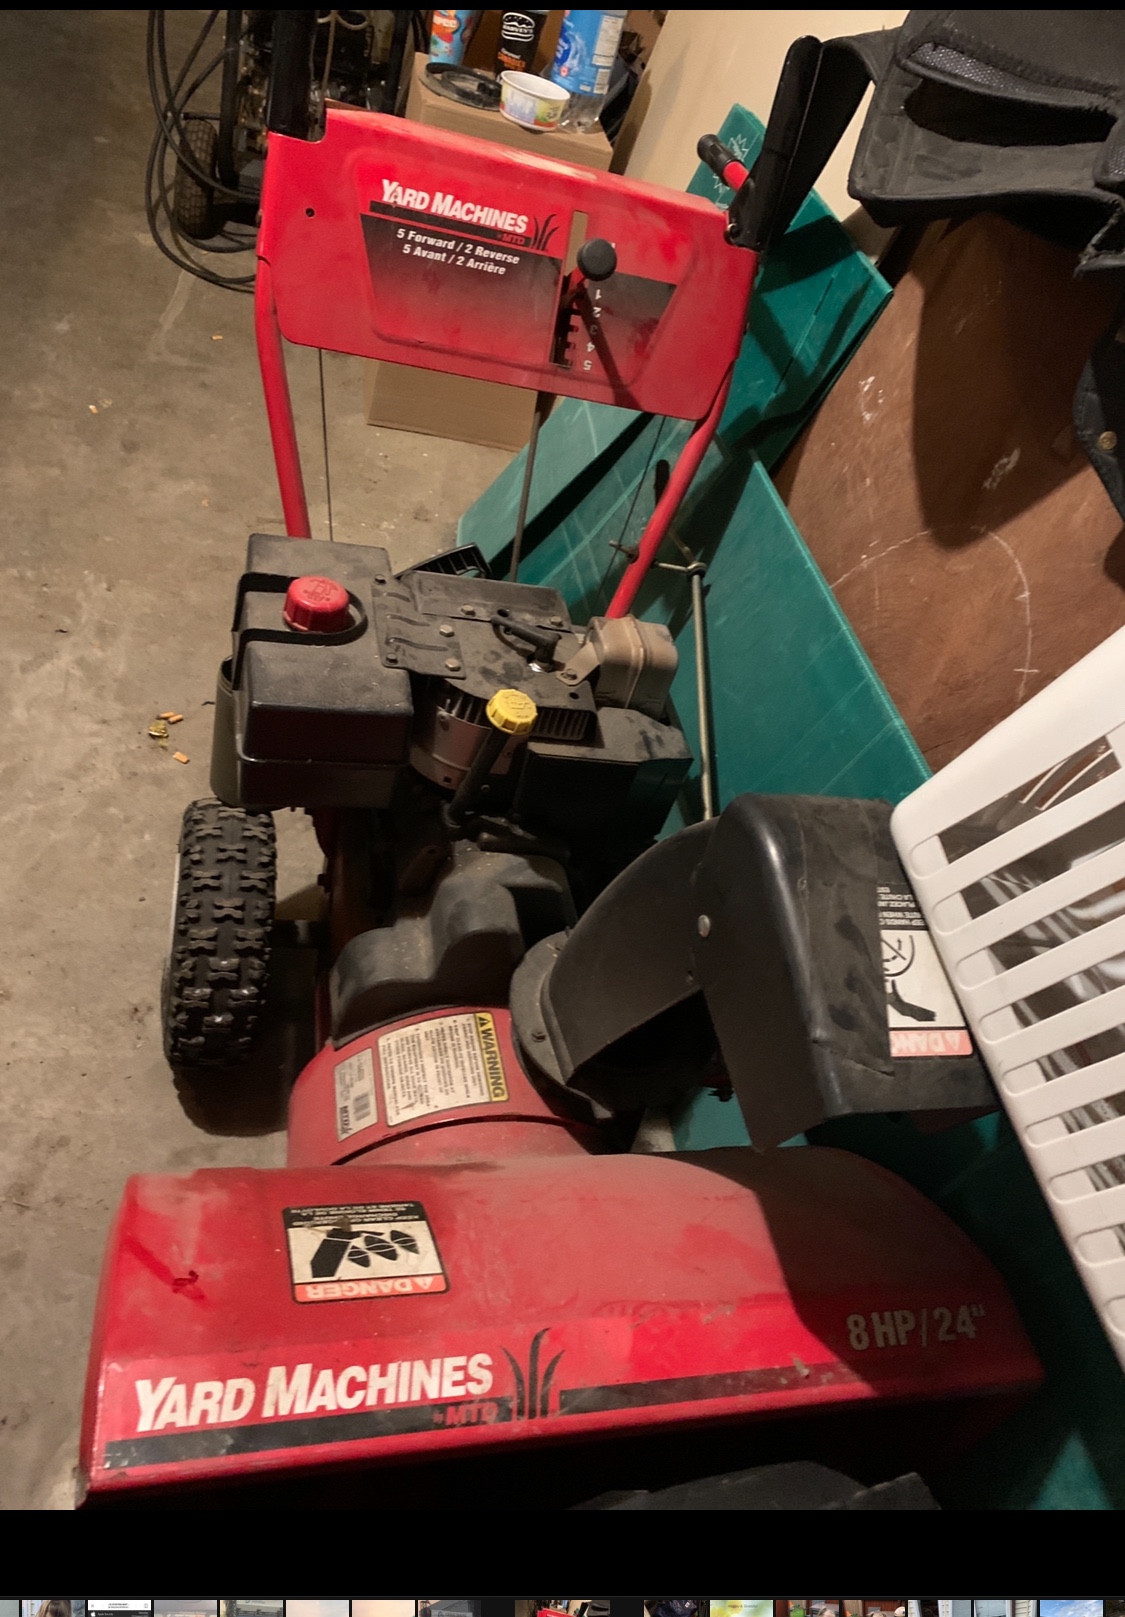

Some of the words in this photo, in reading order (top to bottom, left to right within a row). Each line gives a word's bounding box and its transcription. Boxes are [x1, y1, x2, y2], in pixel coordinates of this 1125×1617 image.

[382, 179, 430, 210] YARD
[431, 192, 528, 233] MACHINES
[397, 228, 405, 239] 5
[408, 231, 455, 250] Forward
[456, 242, 463, 252] /
[465, 244, 473, 254] 2
[475, 247, 520, 264] Reverse
[402, 243, 411, 254] 5
[413, 247, 446, 263] Avant
[448, 256, 454, 264] /
[456, 256, 464, 266] 2
[466, 260, 506, 275] Arrière
[595, 289, 601, 299] 1
[593, 307, 601, 318] 2
[590, 324, 598, 335] 3
[586, 342, 595, 352] 4
[583, 360, 592, 371] 5
[481, 1029, 505, 1098] WARNING
[306, 1278, 413, 1299] DANGER
[846, 1314, 870, 1350] 8
[135, 1376, 256, 1432] YARD
[262, 1353, 494, 1417] MACHINES
